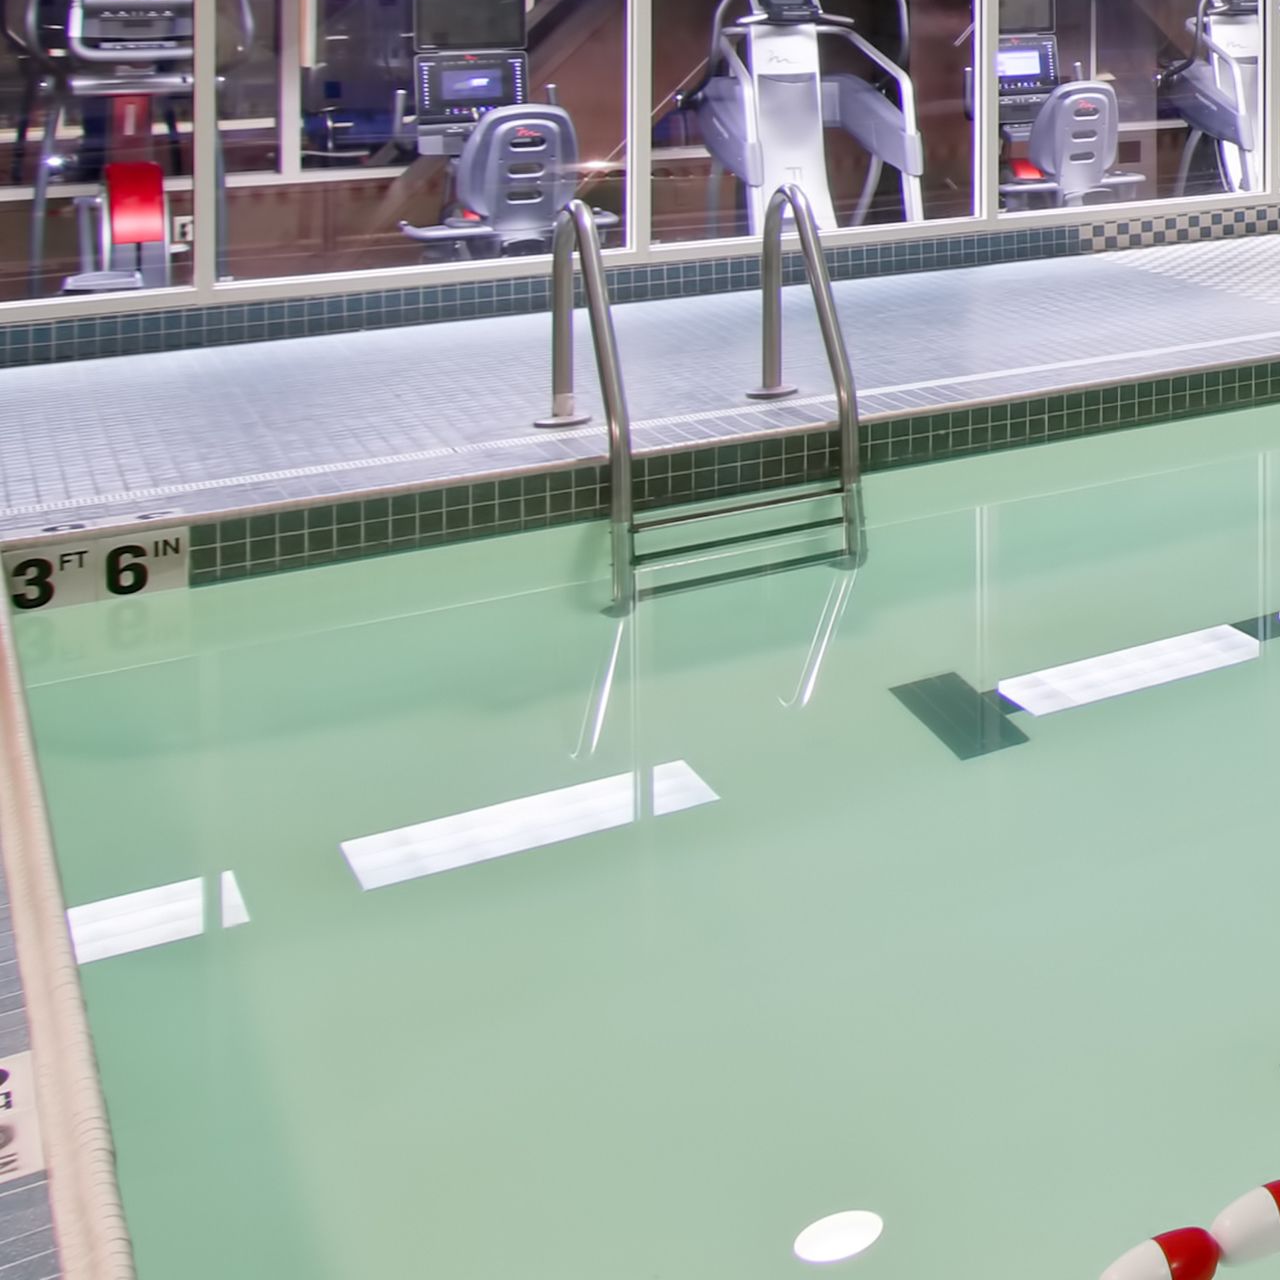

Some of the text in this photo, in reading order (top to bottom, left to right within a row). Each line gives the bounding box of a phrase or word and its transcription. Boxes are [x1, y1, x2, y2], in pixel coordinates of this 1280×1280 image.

[11, 537, 181, 609] 3 FT 6 IN
